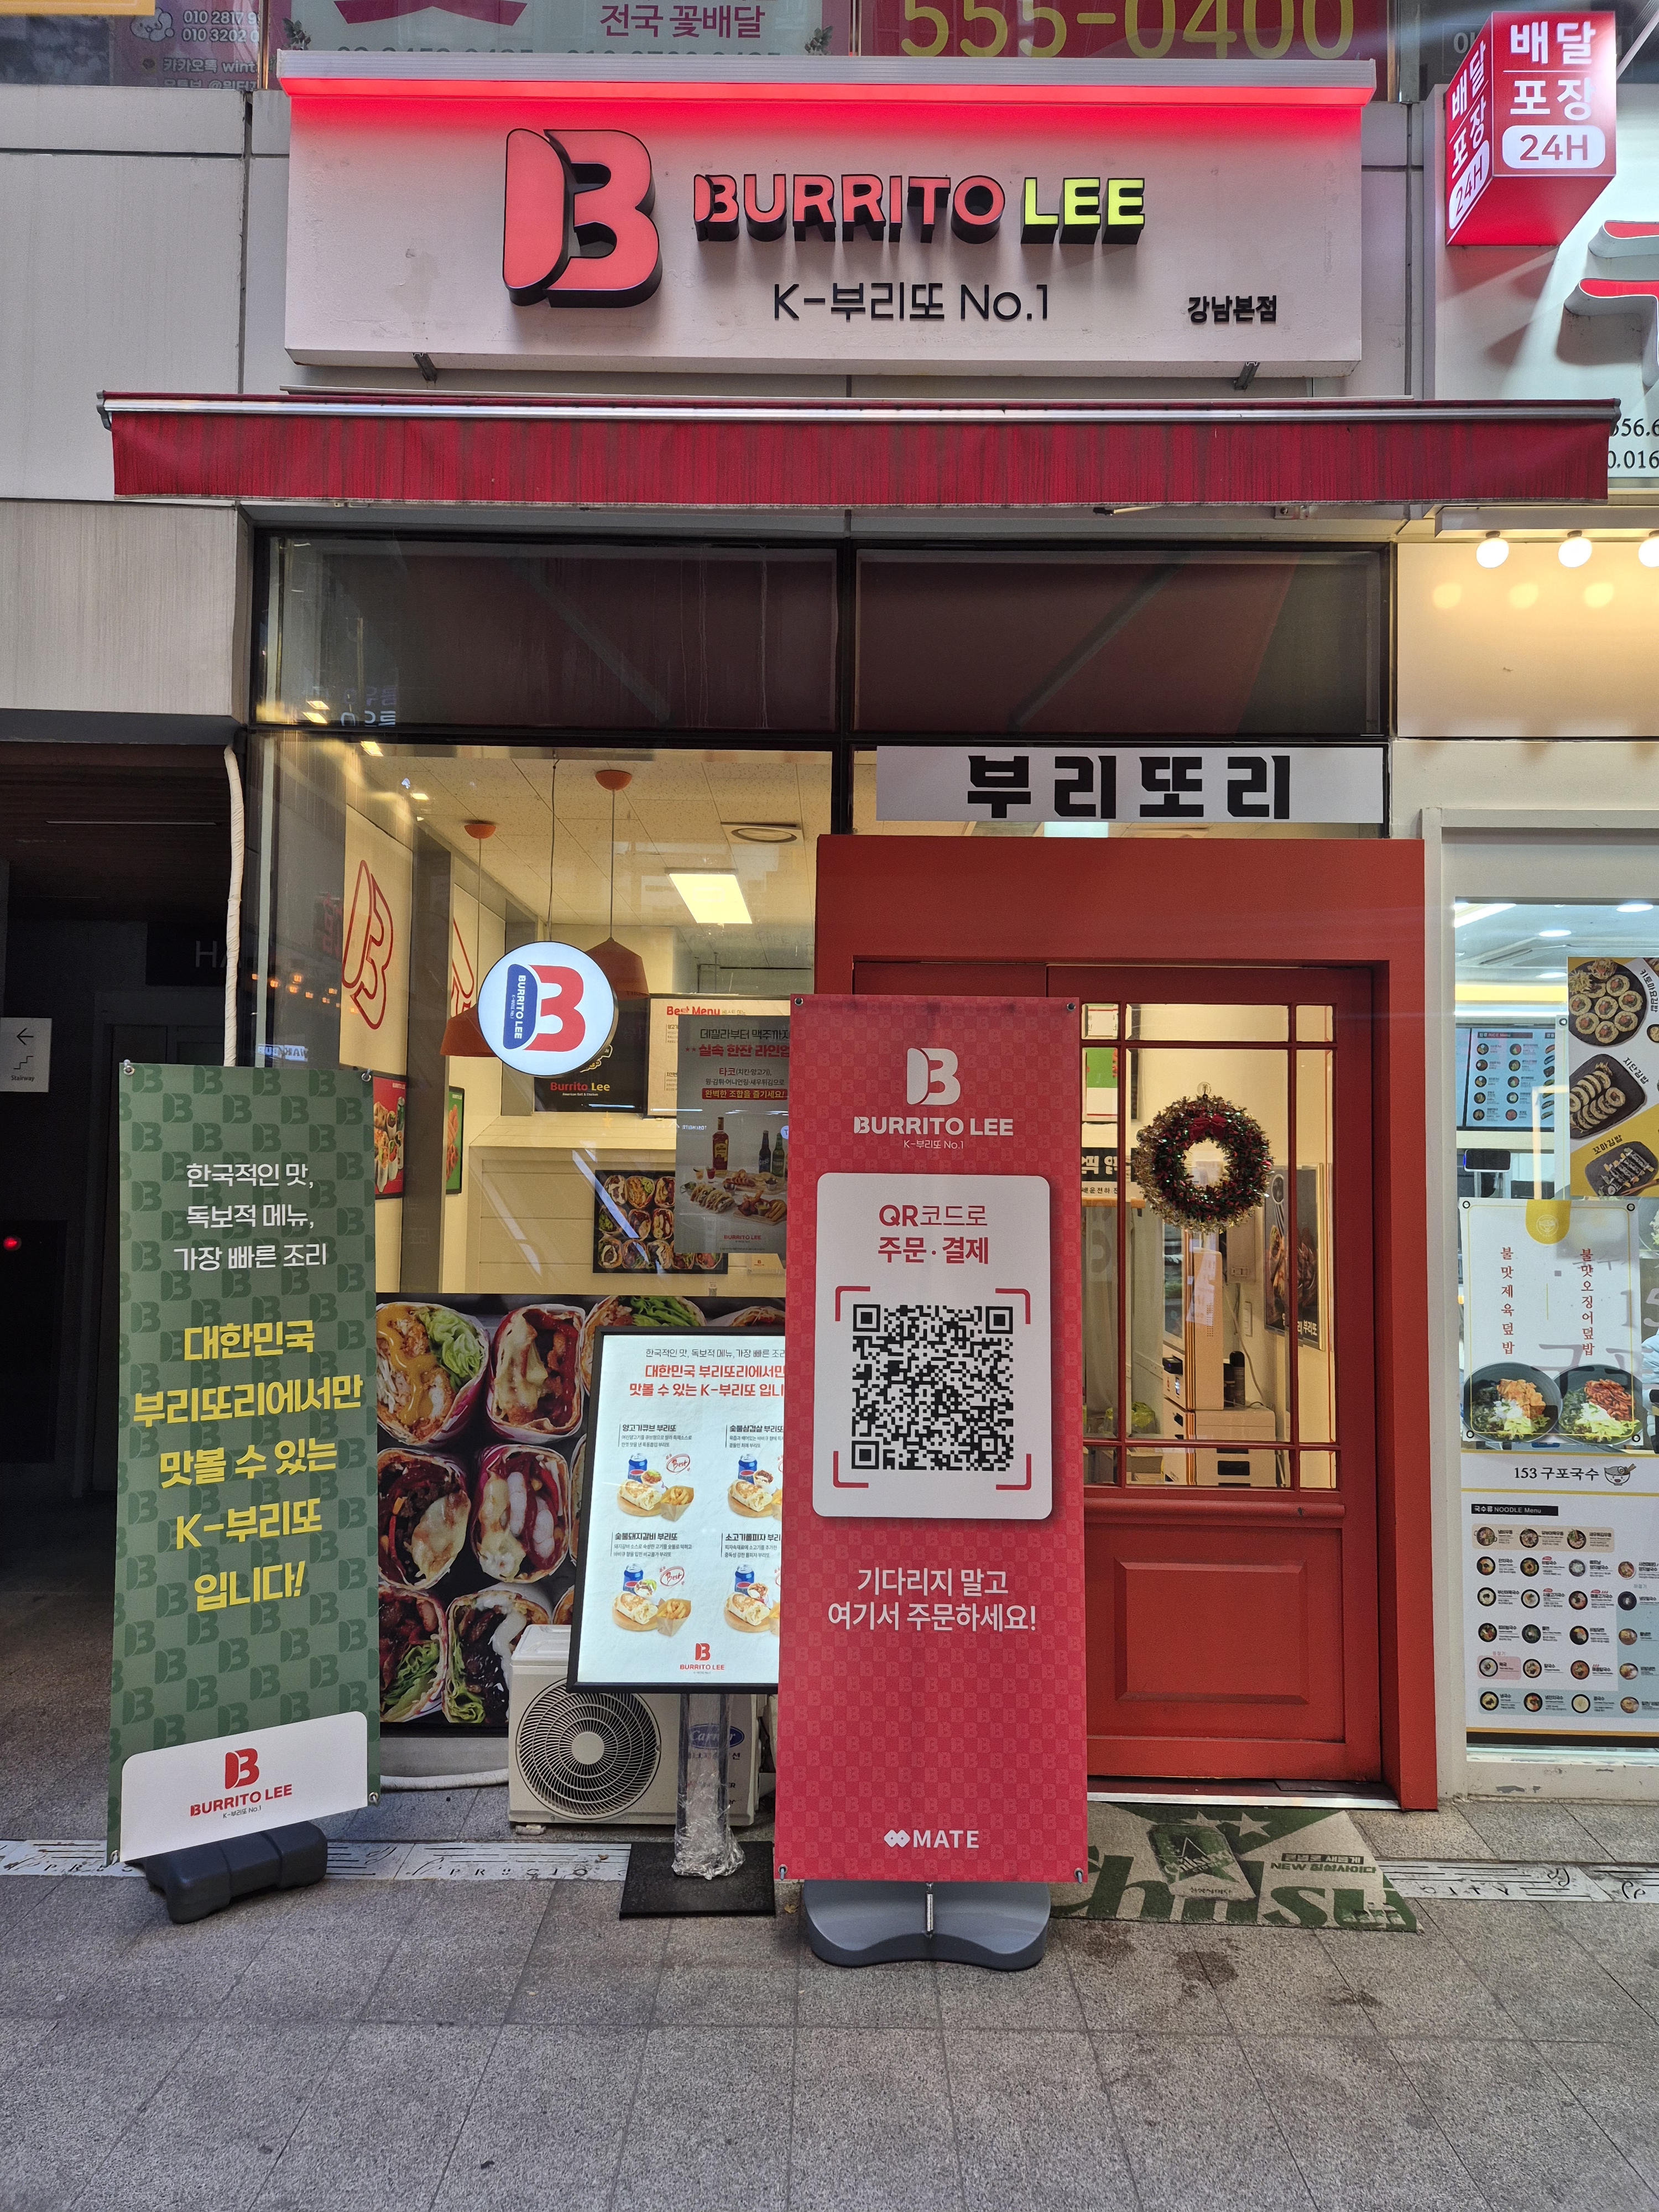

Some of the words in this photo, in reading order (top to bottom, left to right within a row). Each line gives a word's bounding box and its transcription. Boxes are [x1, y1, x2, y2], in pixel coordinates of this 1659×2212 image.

[184, 11, 208, 24] 010
[211, 11, 243, 24] 2817
[600, 4, 664, 38] 전국
[669, 5, 765, 38] 꽃배달
[901, 0, 1354, 59] 555-0400
[182, 28, 206, 41] 010
[210, 29, 246, 42] 3202
[1510, 21, 1596, 64] 배달
[163, 58, 217, 72] 카카오톡
[1451, 40, 1486, 121] 배달
[1510, 77, 1596, 121] 포장
[1452, 95, 1485, 180] 포장
[1519, 134, 1588, 161] 24H
[1455, 152, 1483, 219] 24H
[693, 174, 1005, 243] BURRITO
[1021, 177, 1145, 244] LEE
[774, 283, 944, 322] K-부리또
[960, 284, 1047, 321] No.1
[1188, 295, 1277, 324] 강남본점
[967, 755, 1290, 819] 부리또리
[515, 975, 526, 1019] BURRITO
[1640, 969, 1658, 1013] 키토마요김밥
[514, 1021, 523, 1039] LEE
[699, 1044, 724, 1057] 실속
[727, 1044, 752, 1057] 한잔
[1623, 1057, 1649, 1084] 지단김밥
[550, 1082, 588, 1092] Burrito
[591, 1082, 610, 1092] Lee
[705, 1090, 727, 1098] 완벽한
[729, 1090, 750, 1099] 조합을
[753, 1091, 785, 1099] 즐기세요!
[854, 1117, 963, 1135] BURRITO
[970, 1118, 1014, 1136] LEE
[904, 1140, 941, 1150] K-부리또
[943, 1140, 964, 1150] No.1
[1593, 1135, 1623, 1155] 꼬마김밥
[186, 1164, 279, 1188] 한국적인
[286, 1164, 313, 1188] 맛,
[186, 1204, 255, 1229] 독보적
[263, 1203, 314, 1229] 메뉴,
[879, 1204, 988, 1227] QR코드로
[174, 1246, 222, 1271] 가장
[228, 1244, 276, 1270] 빠른
[283, 1243, 327, 1267] 조리
[1500, 1247, 1515, 1355] 불맛제육덮밥
[1580, 1249, 1594, 1355] 불맛오징어덮밥
[184, 1320, 315, 1360] 대한민국
[645, 1349, 677, 1358] 한국적인
[679, 1349, 689, 1359] 맛,
[691, 1349, 714, 1358] 독보적
[716, 1349, 734, 1359] 메뉴,
[735, 1349, 751, 1358] 가장
[753, 1349, 769, 1358] 빠른
[645, 1365, 695, 1379] 대한민국
[133, 1374, 363, 1427] 부리또리에서만
[629, 1384, 654, 1397] 맛볼
[658, 1384, 670, 1397] 수
[673, 1384, 697, 1397] 있는
[701, 1384, 756, 1397] K-부리또
[160, 1447, 226, 1488] 맛볼
[235, 1444, 267, 1479] 수
[275, 1438, 337, 1475] 있는
[1514, 1467, 1537, 1480] 153
[1540, 1467, 1599, 1481] 구포국수
[176, 1498, 322, 1550] K-부리또
[615, 1532, 656, 1541] 숯불돼지갈비
[657, 1532, 677, 1541] 부리또
[194, 1561, 306, 1612] 입니다!
[858, 1567, 952, 1597] 기다리지
[961, 1568, 1008, 1597] 말고
[828, 1601, 899, 1631] 여기서
[906, 1603, 1036, 1632] 주문하세요!
[190, 1791, 262, 1817] BURRITO
[265, 1784, 292, 1801] LEE
[223, 1808, 247, 1819] K-부리또
[248, 1805, 262, 1813] No.1
[913, 1830, 979, 1849] MATE
[1270, 1863, 1307, 1871] NEW
